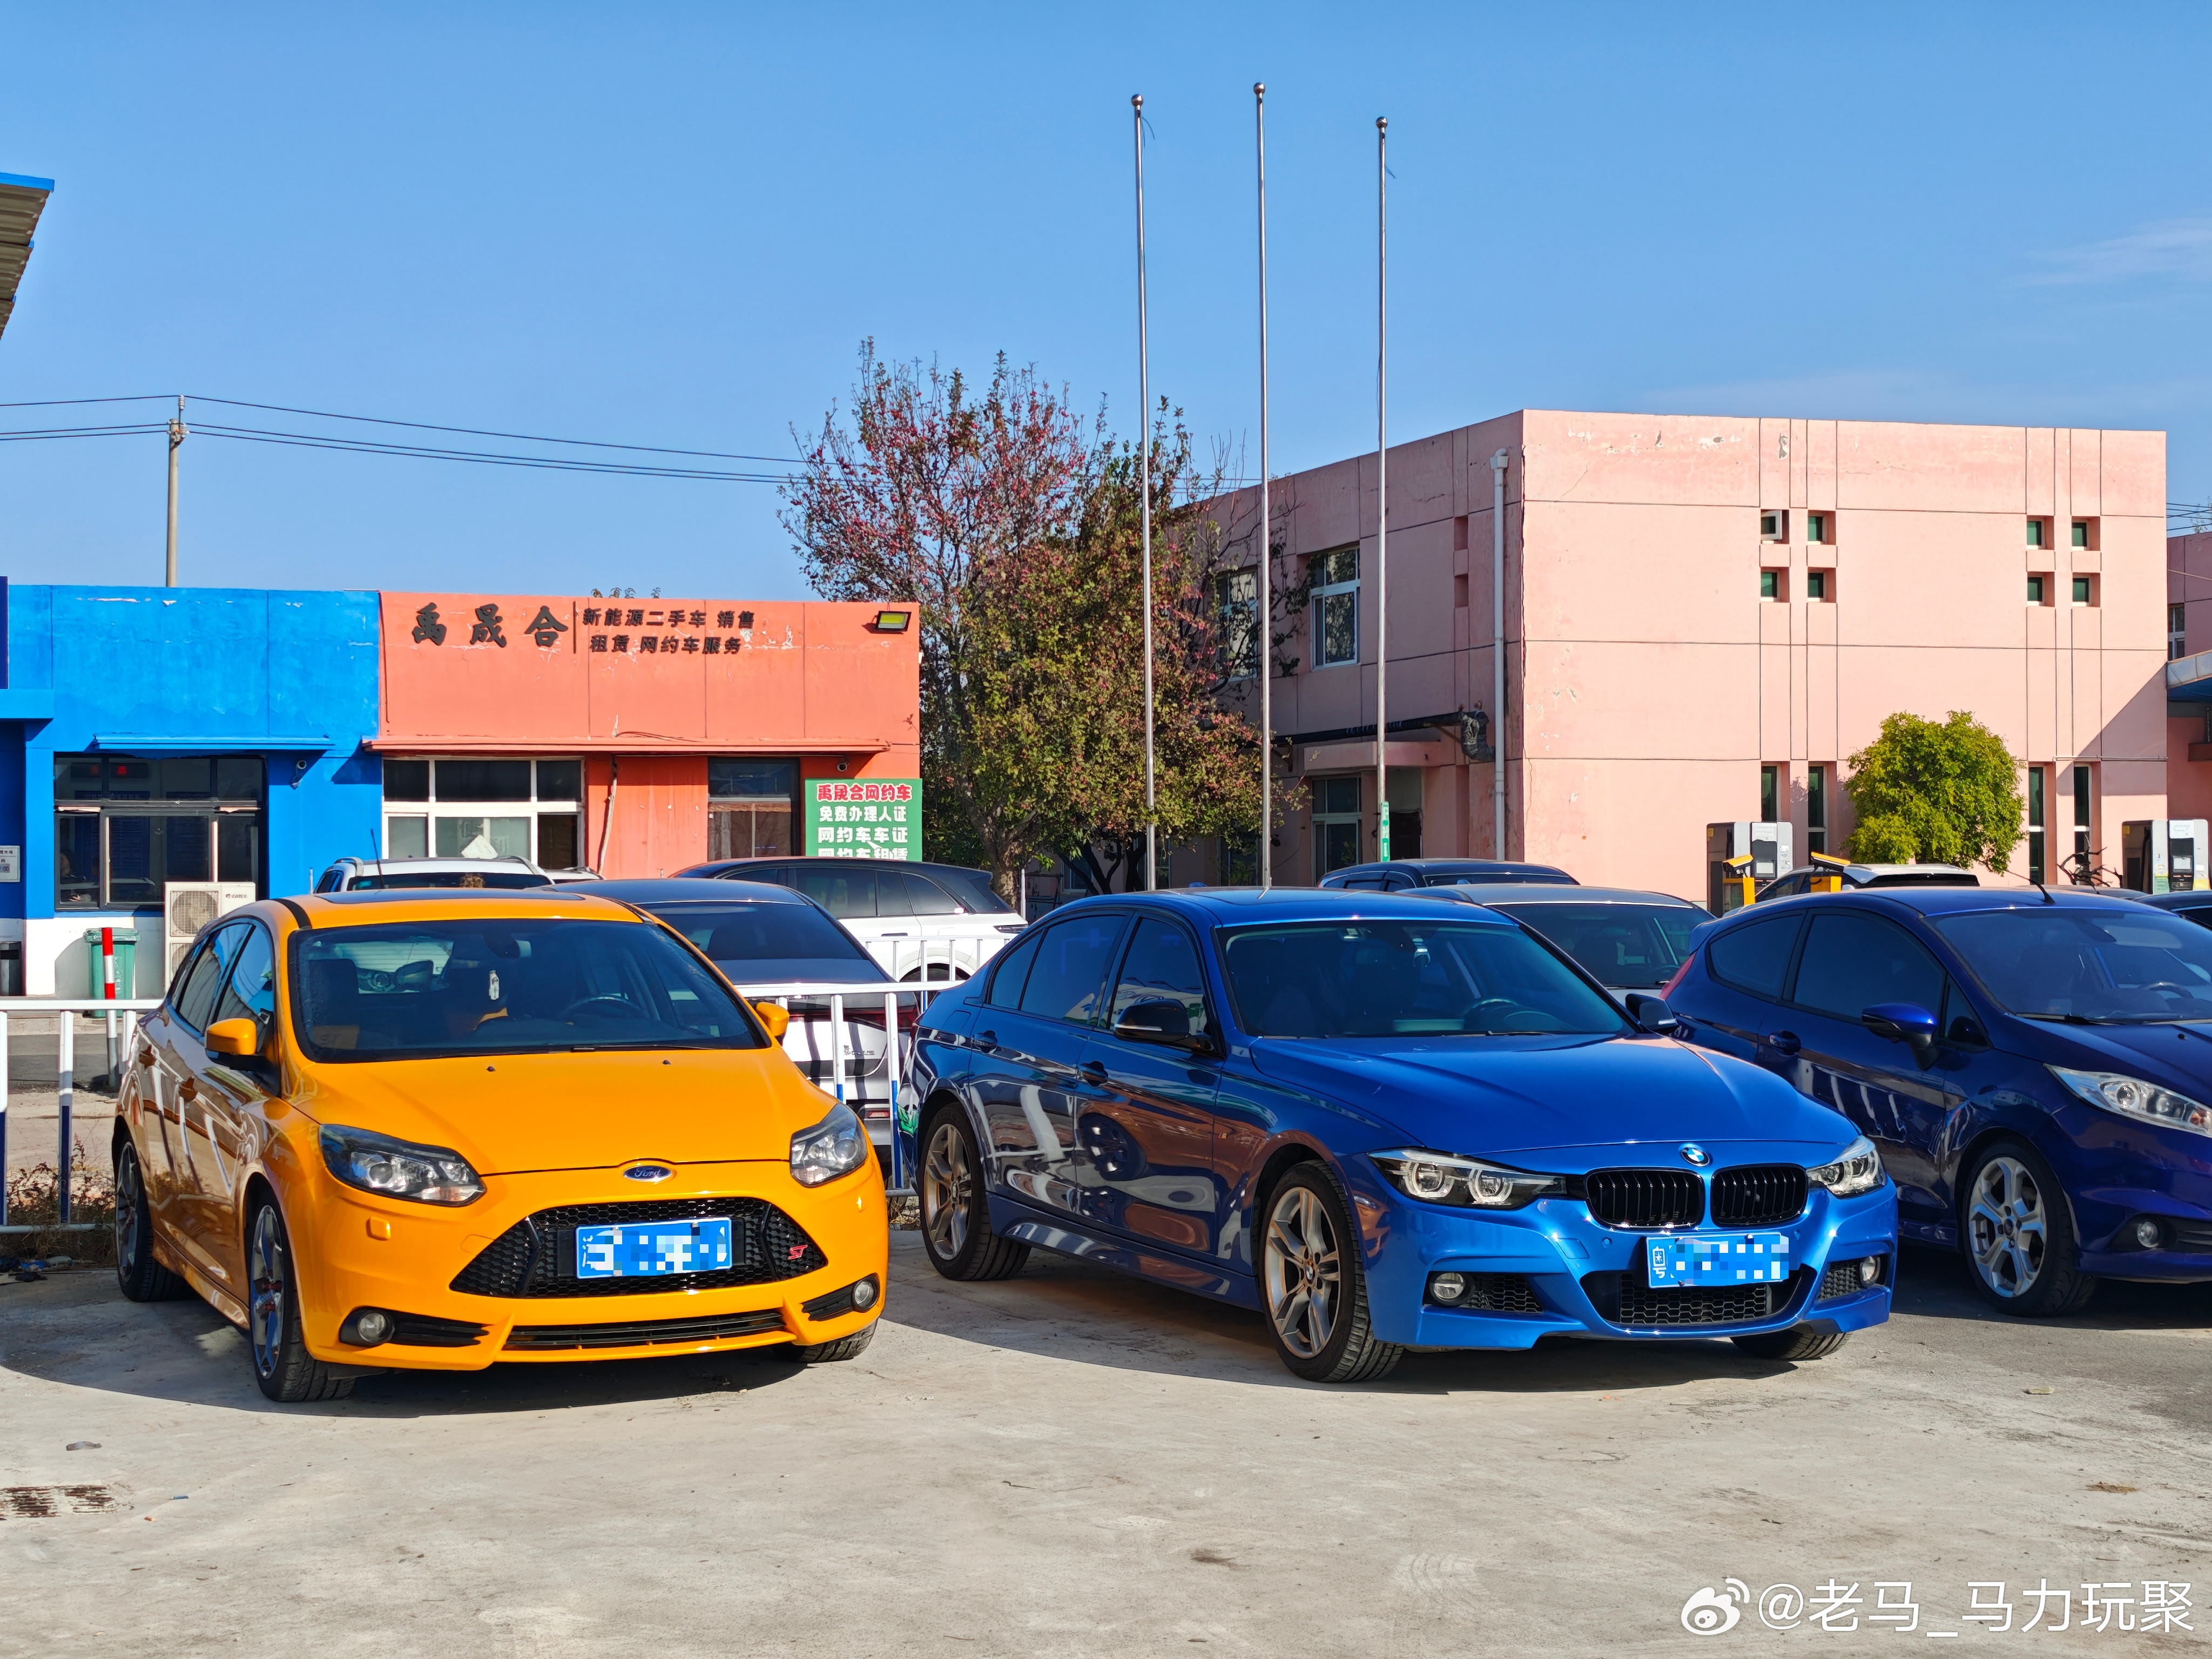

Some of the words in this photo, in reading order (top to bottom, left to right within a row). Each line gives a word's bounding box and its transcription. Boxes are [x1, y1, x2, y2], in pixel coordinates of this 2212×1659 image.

[412, 602, 569, 648] 禹晟合
[582, 608, 707, 628] 新能源二手车
[717, 610, 754, 629] 销售
[589, 635, 630, 653] 租赁
[639, 636, 741, 655] 网约车服务
[817, 784, 913, 801] 禹晟合网约车
[819, 806, 907, 822] 免费办理人证
[818, 827, 908, 844] 网约车车证
[634, 1166, 662, 1177] Ford
[787, 1244, 808, 1260] ST
